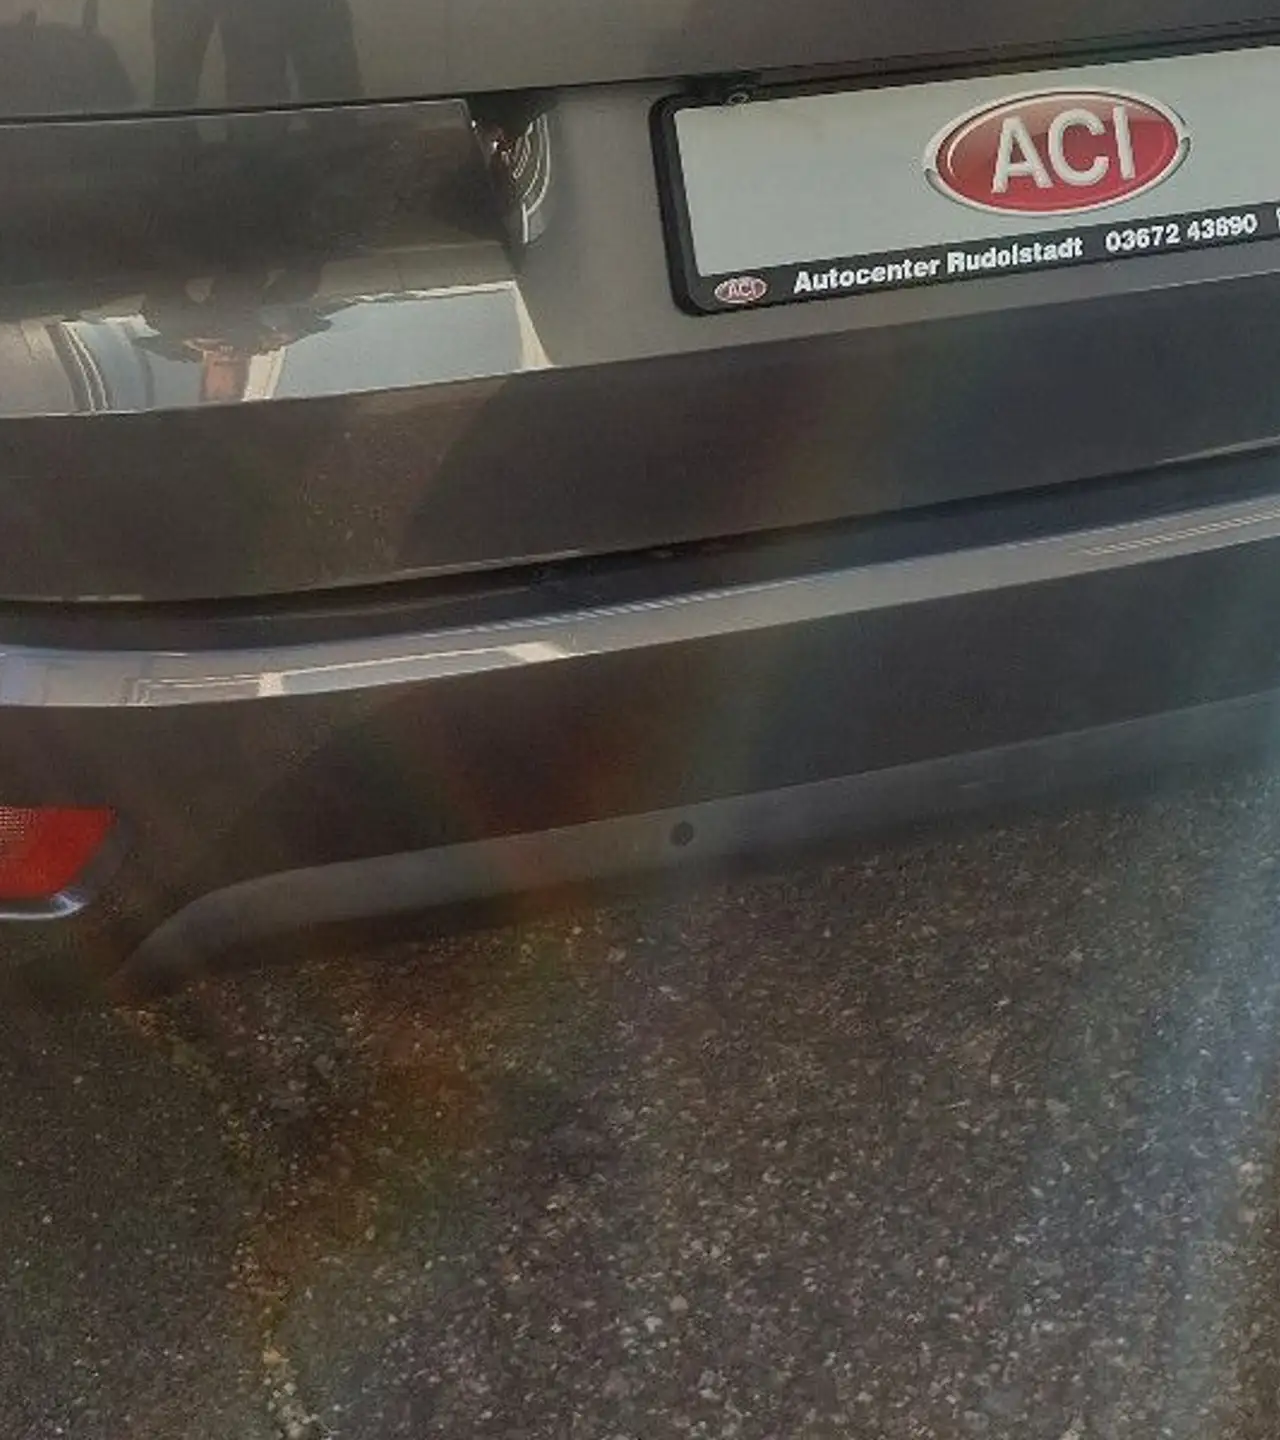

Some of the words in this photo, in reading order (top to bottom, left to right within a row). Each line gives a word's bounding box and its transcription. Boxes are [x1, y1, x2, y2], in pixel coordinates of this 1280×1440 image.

[990, 105, 1136, 194] ACI
[793, 257, 940, 294] Autocenter
[946, 236, 1083, 274] Rudolstadt
[1105, 222, 1181, 253] 03672
[1186, 212, 1258, 243] 43890
